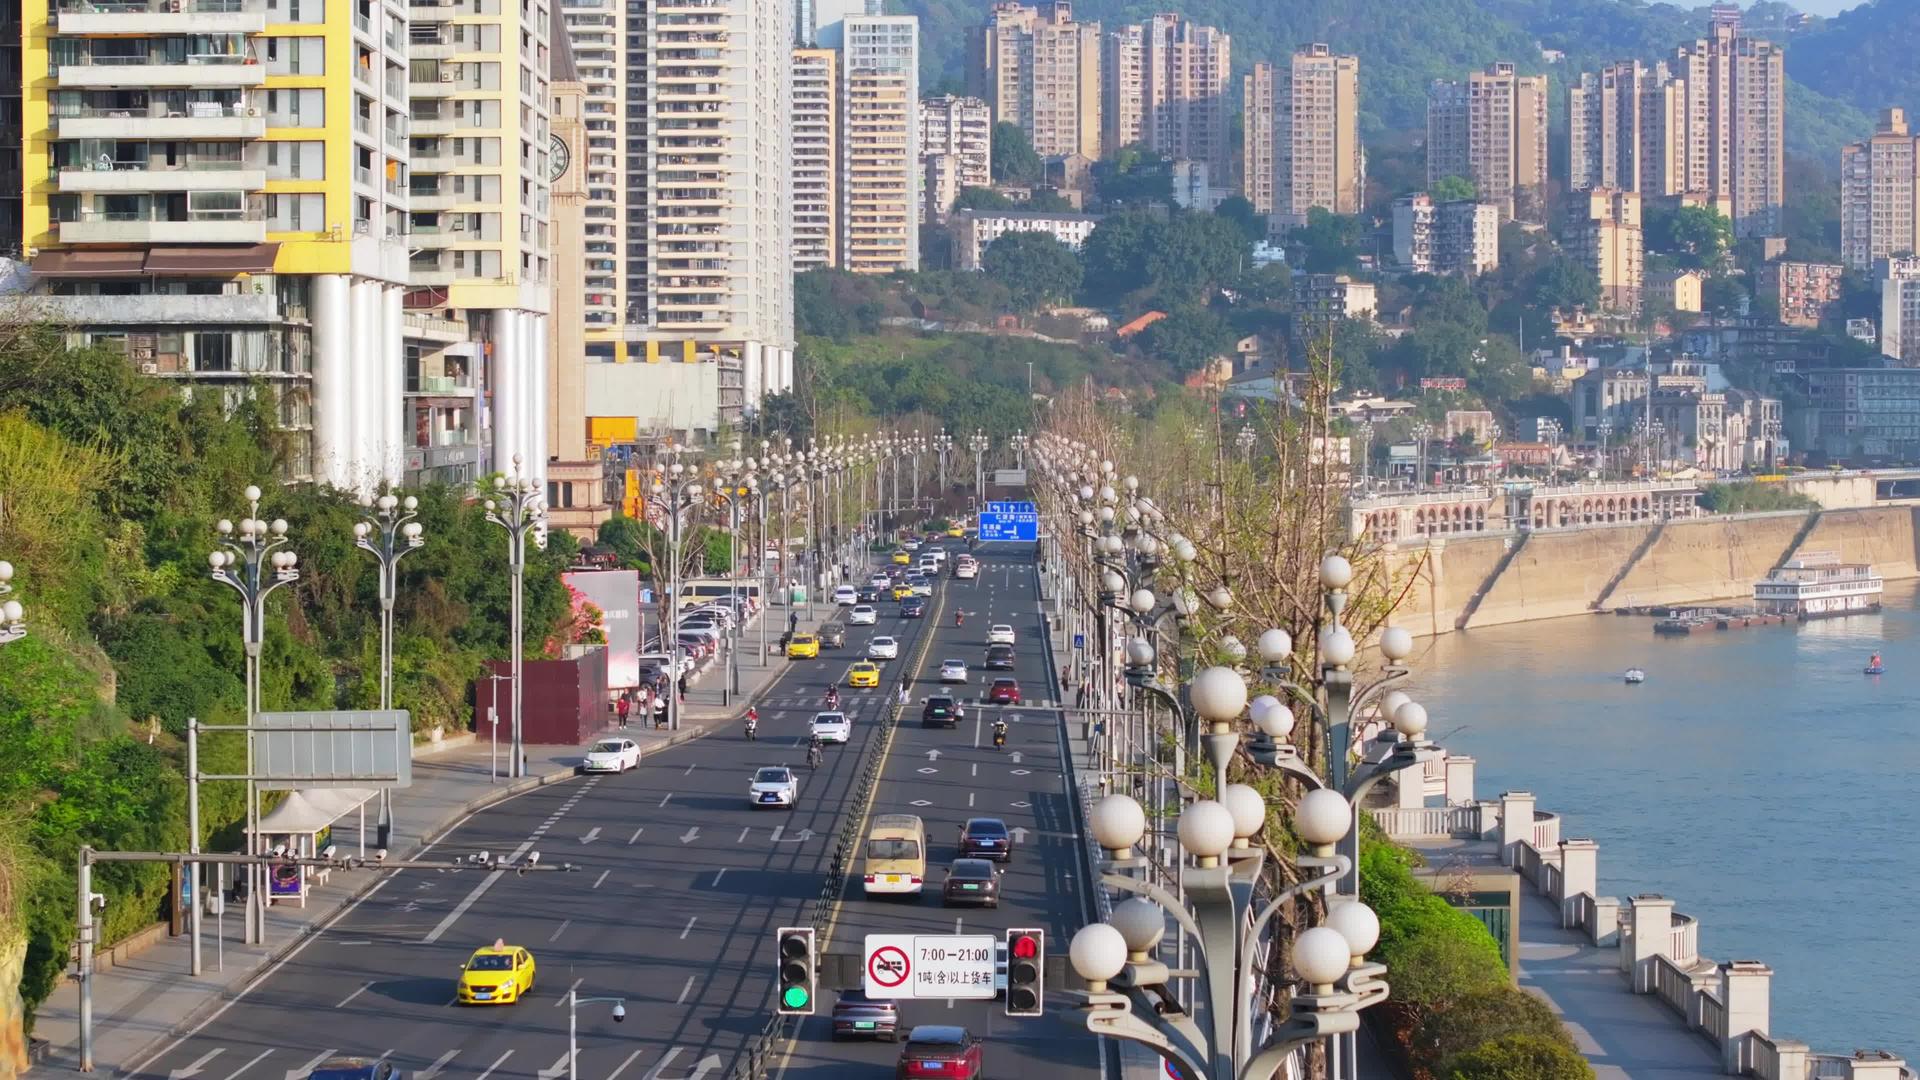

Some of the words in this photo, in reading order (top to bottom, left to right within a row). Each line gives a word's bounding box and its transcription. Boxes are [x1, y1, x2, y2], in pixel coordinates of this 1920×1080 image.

[918, 970, 992, 985] 1吨(含)以上货车
